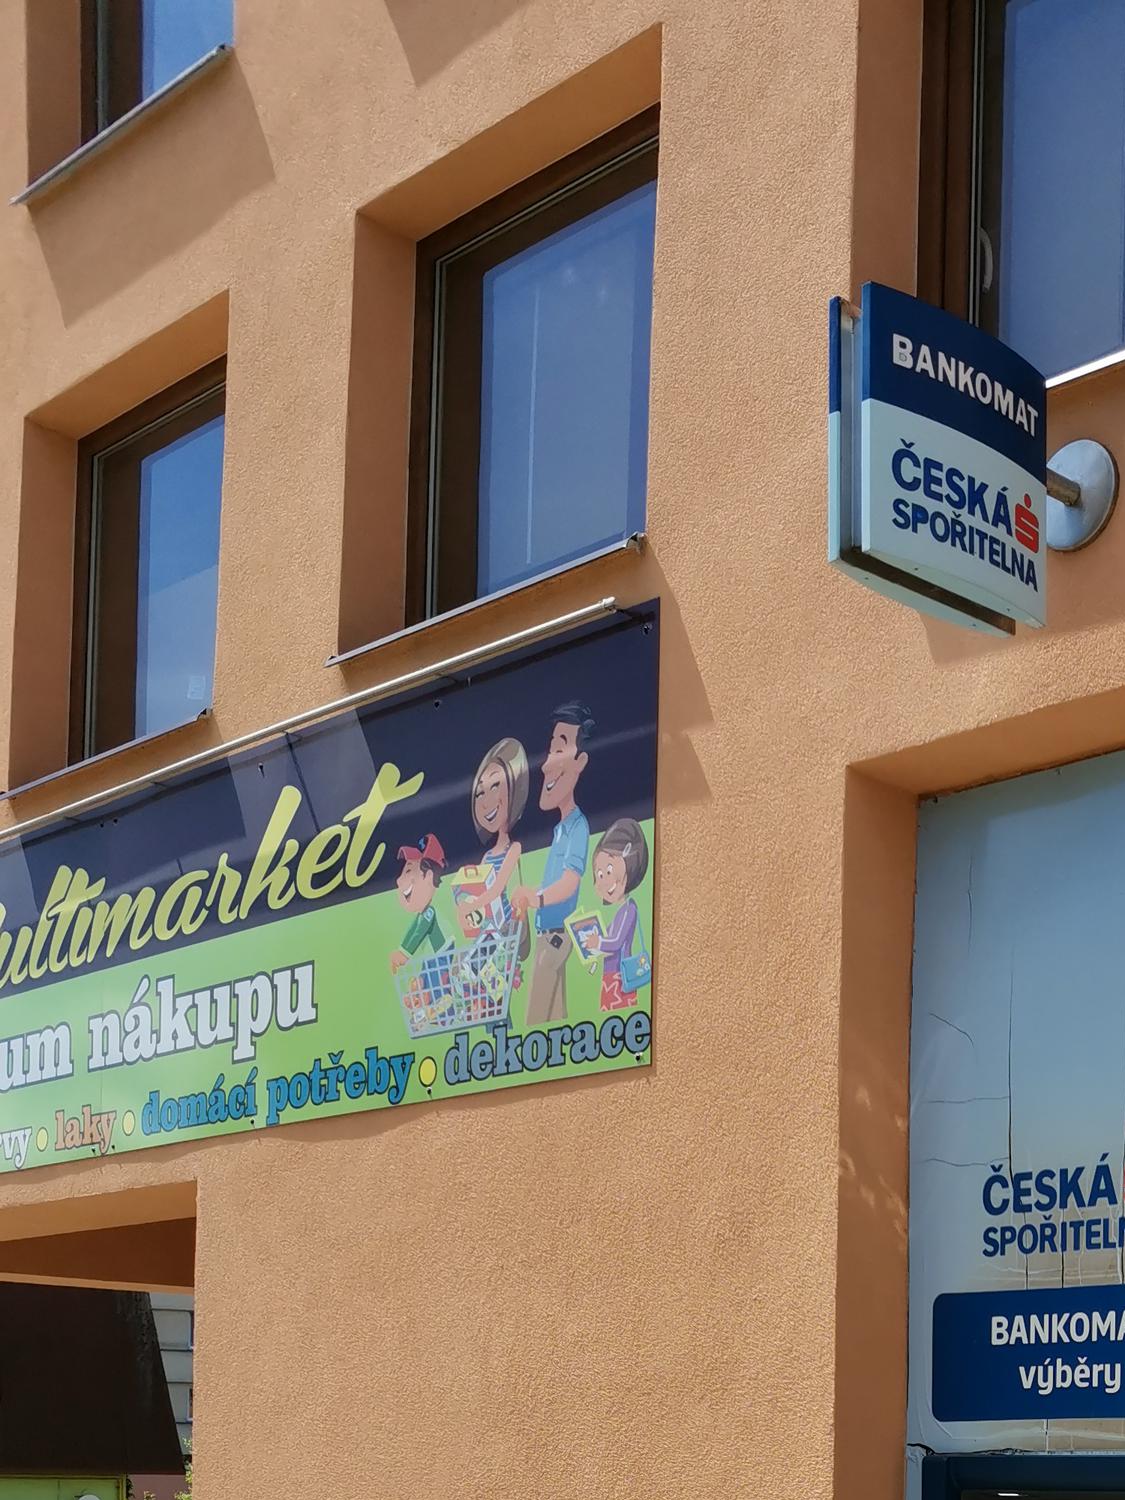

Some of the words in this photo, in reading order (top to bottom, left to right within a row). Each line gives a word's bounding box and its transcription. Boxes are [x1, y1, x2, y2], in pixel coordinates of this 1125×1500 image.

[892, 333, 1038, 437] BANKOMAT
[892, 438, 1013, 538] ČESKÁ
[892, 498, 1039, 592] SPOŘITELNA
[0, 762, 424, 989] ultimarket
[87, 961, 319, 1071] nákupu
[0, 1126, 33, 1169] vy
[55, 1104, 117, 1156] laky
[141, 1066, 258, 1136] domácí
[266, 1046, 415, 1125] potřeby
[444, 1010, 652, 1086] dekorace
[982, 1152, 1118, 1216] ČESKÁ
[1018, 1358, 1122, 1395] výběry
